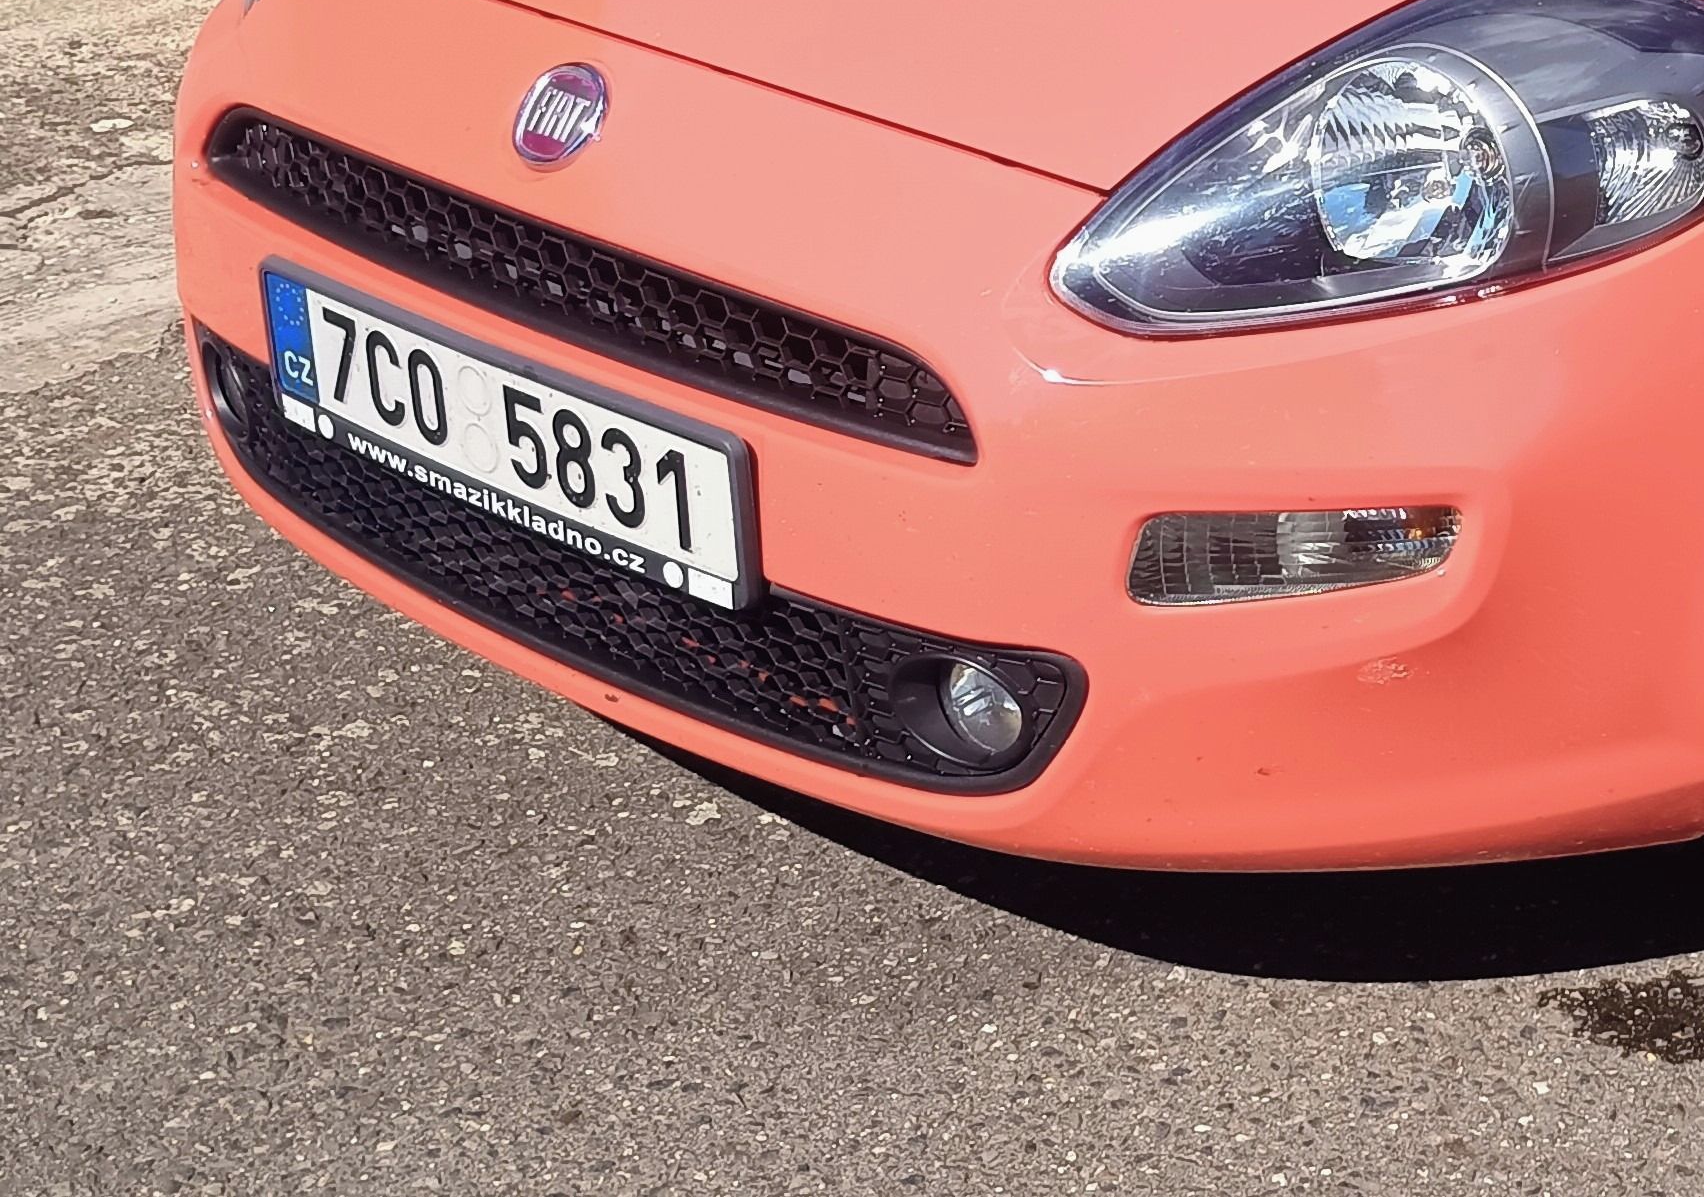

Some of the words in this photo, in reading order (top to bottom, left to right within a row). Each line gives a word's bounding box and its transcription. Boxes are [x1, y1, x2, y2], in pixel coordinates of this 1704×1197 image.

[527, 86, 591, 143] FIAT
[283, 350, 314, 386] CZ
[321, 306, 448, 446] 7C0
[502, 384, 692, 553] 5831
[346, 432, 647, 574] www.smazikkladno.cz
